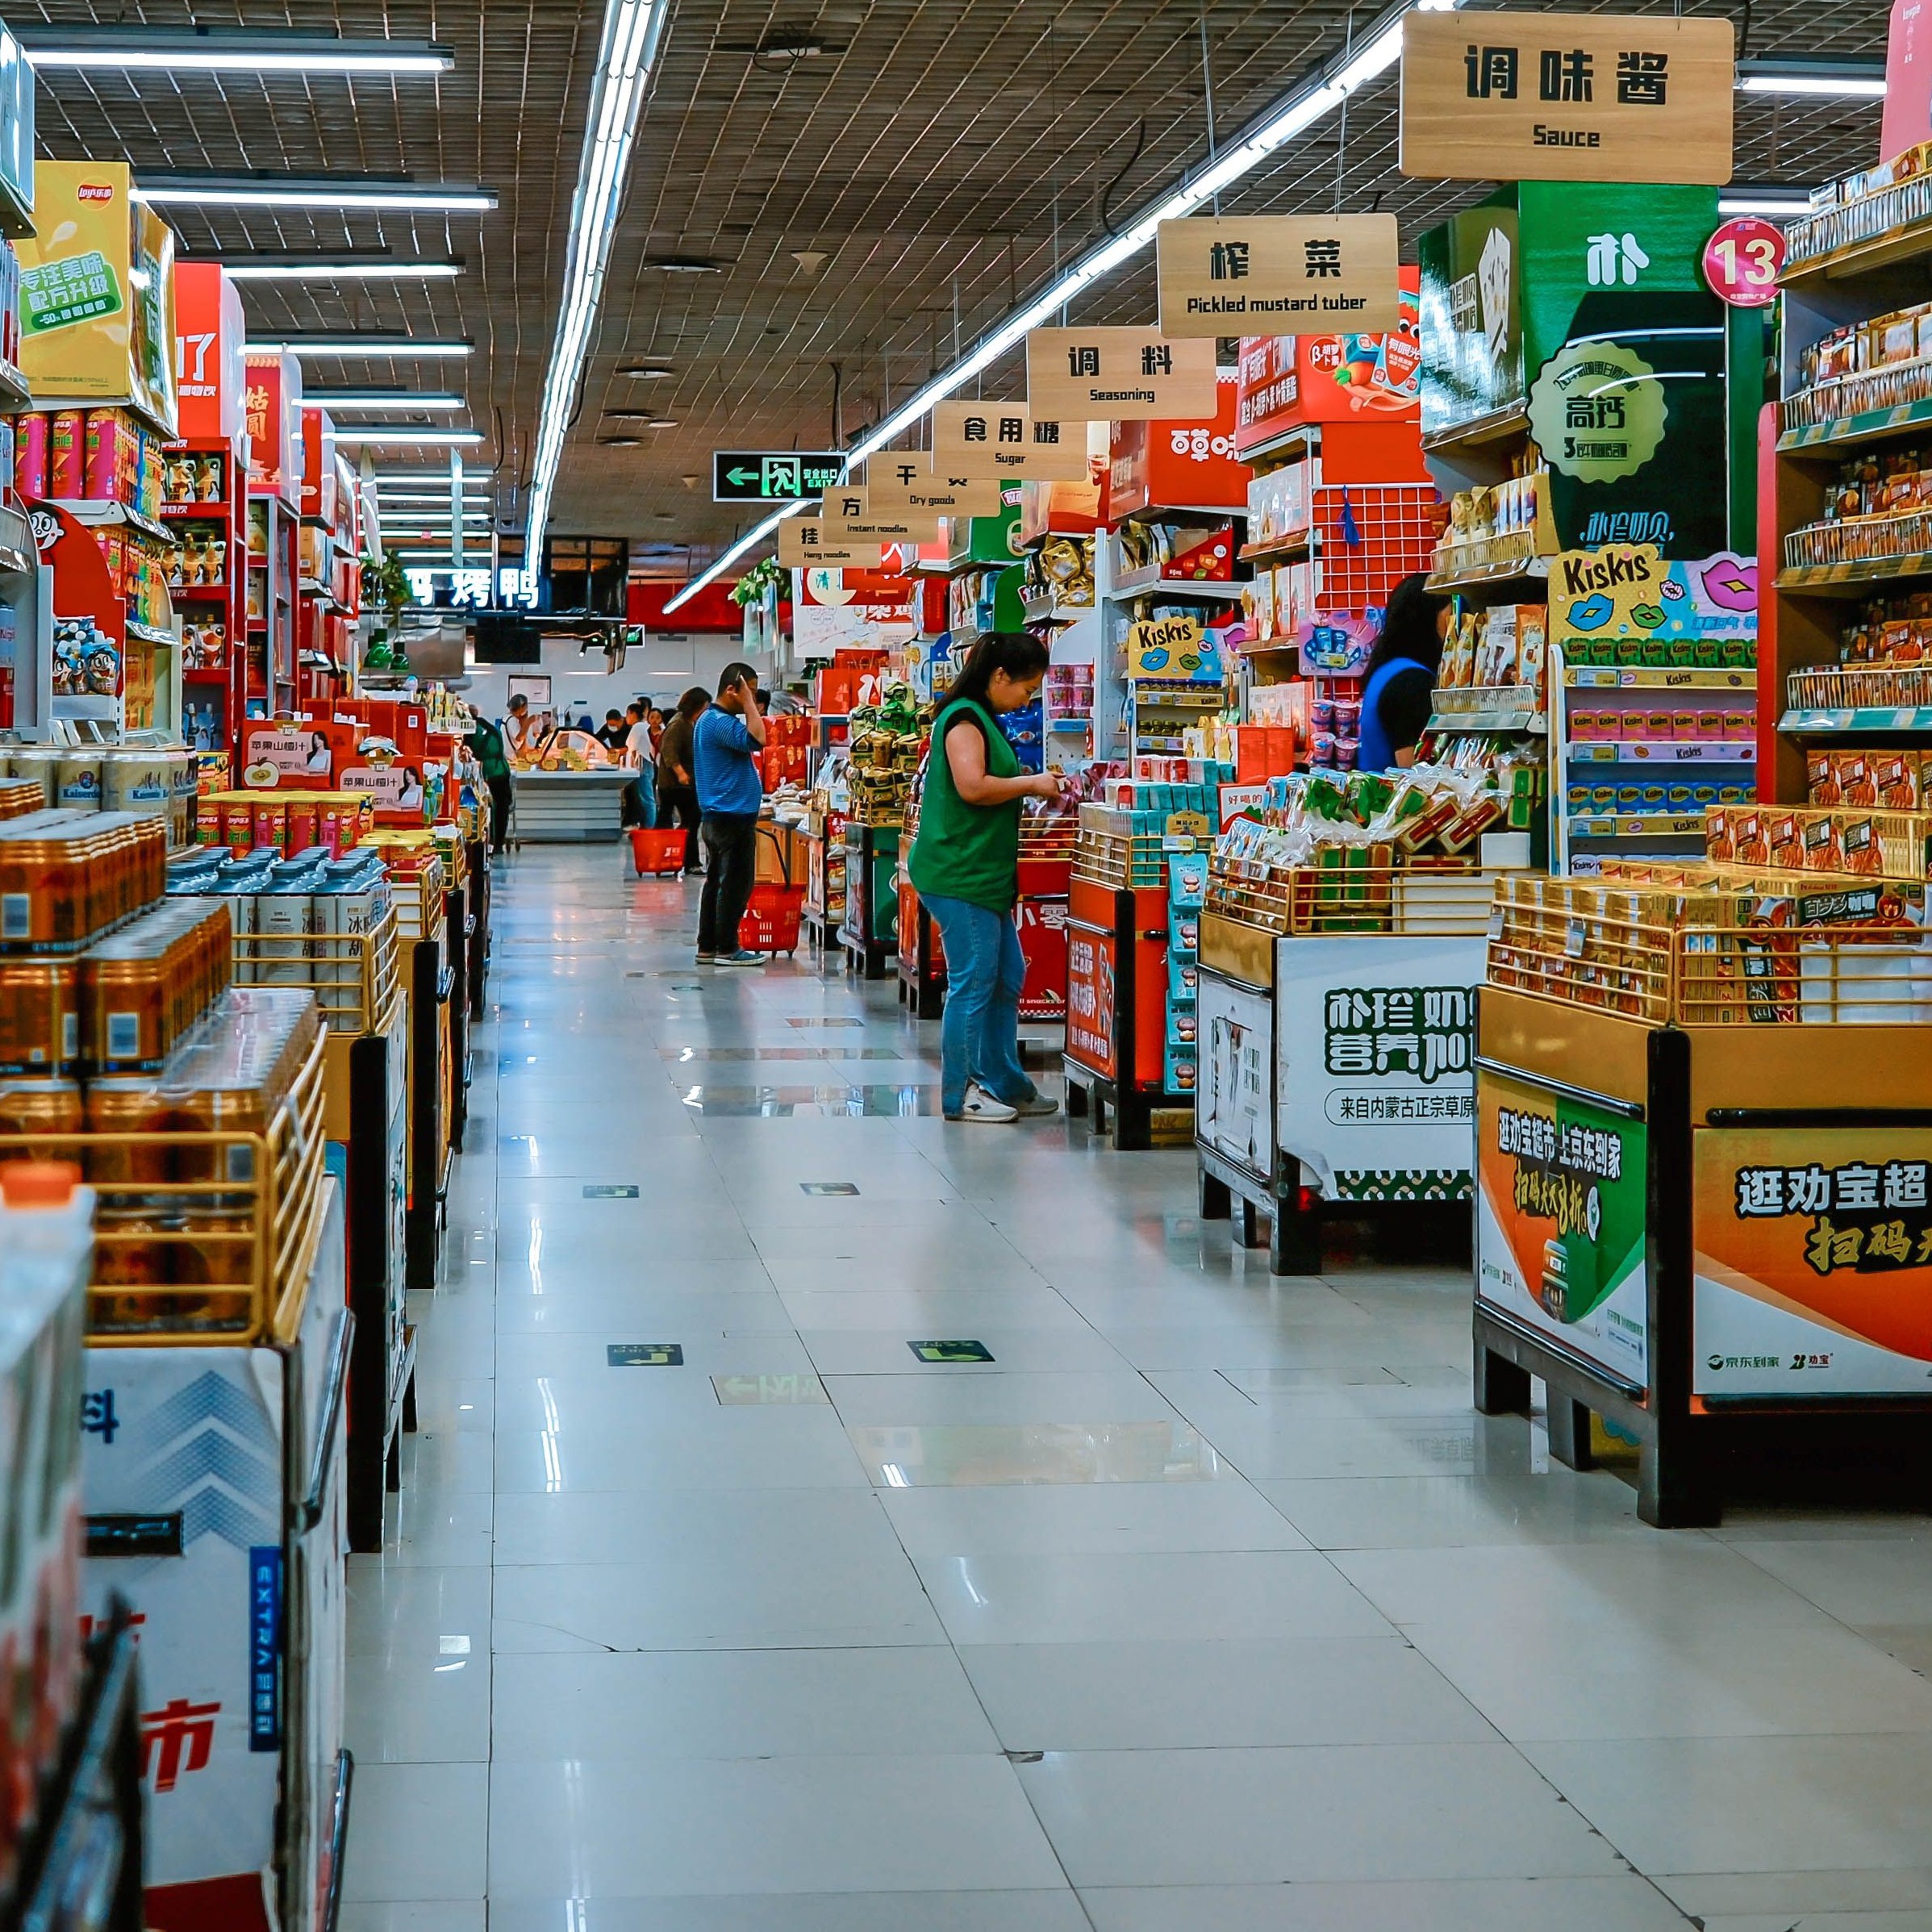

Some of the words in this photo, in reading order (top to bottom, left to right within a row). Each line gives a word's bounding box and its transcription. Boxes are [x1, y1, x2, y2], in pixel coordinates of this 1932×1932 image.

[1464, 44, 1668, 105] 调味酱
[1533, 125, 1600, 148] Sauce
[1210, 239, 1341, 280] 榨菜
[1714, 239, 1776, 285] 13
[20, 254, 103, 291] 专注美味
[27, 275, 110, 313] 配方升级
[1187, 295, 1246, 314] Pickled
[1250, 294, 1318, 312] mustard
[1321, 294, 1367, 311] tuber
[1068, 345, 1173, 377] 调料
[1090, 388, 1155, 403] Seasoning
[1566, 394, 1625, 429] 高钙
[963, 416, 1059, 444] 食用糖
[995, 453, 1026, 465] Sugar
[803, 469, 837, 480] 安全出口
[807, 479, 833, 488] EXIT
[842, 497, 862, 516] 方
[909, 495, 929, 507] Dry
[932, 494, 956, 507] goods
[801, 527, 819, 545] 挂
[847, 524, 875, 533] Instant
[878, 524, 908, 533] noodles
[1563, 553, 1651, 596] Kiskis
[1137, 622, 1192, 649] Kiskis
[1666, 674, 1692, 686] Kiskis
[251, 741, 306, 752] 苹果山楂汁
[1676, 747, 1703, 760] Kiskis
[343, 777, 398, 787] 苹果山楂汁
[1229, 795, 1262, 805] 好喝的
[1673, 820, 1700, 832] Kiskis
[1329, 990, 1473, 1029] 朴珍奶
[1329, 1033, 1473, 1083] 营养加
[1340, 1095, 1473, 1119] 来自内蒙古正宗草原
[1499, 1110, 1556, 1162] 逛劝宝超市
[1559, 1123, 1621, 1179] 上京东到家
[1738, 1163, 1928, 1214] 逛劝宝超
[1725, 1354, 1780, 1369] 京东到家
